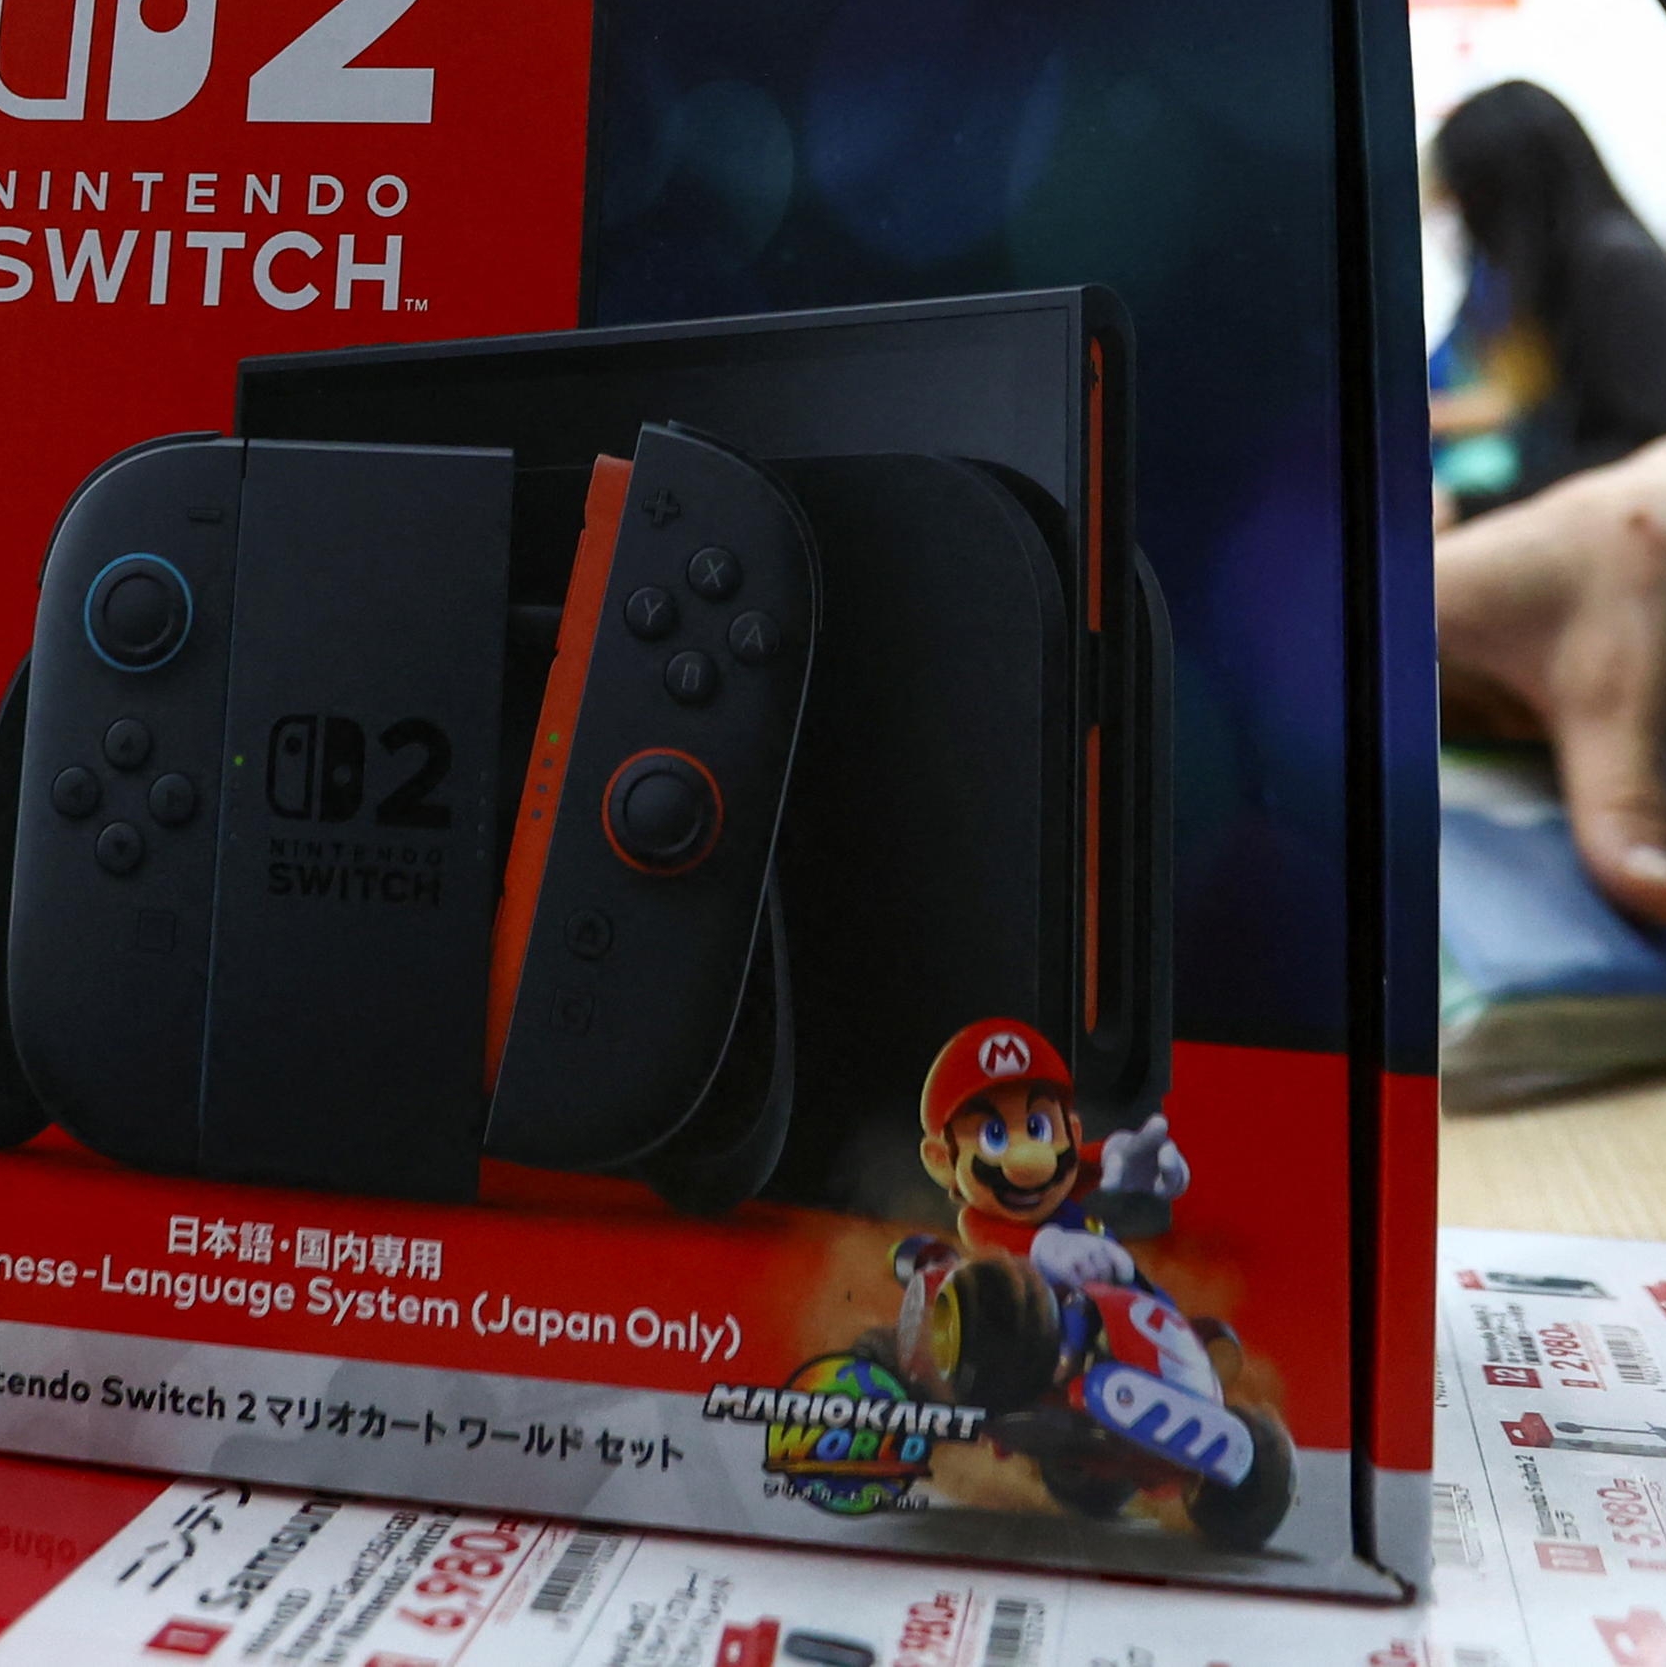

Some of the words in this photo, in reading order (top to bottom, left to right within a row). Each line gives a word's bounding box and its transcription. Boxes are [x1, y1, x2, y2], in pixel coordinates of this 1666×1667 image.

[266, 863, 443, 906] SWITCH
[168, 1215, 443, 1281] 日本語・国内専用
[306, 1276, 459, 1327] System
[471, 1291, 616, 1346] (Japan
[626, 1306, 742, 1363] Only)
[101, 1375, 226, 1421] Switch
[266, 1394, 446, 1446] マリオカート
[459, 1417, 583, 1461] ワールド
[595, 1434, 684, 1472] セット
[767, 1423, 927, 1463] WORLD
[197, 1492, 348, 1614] Samsun
